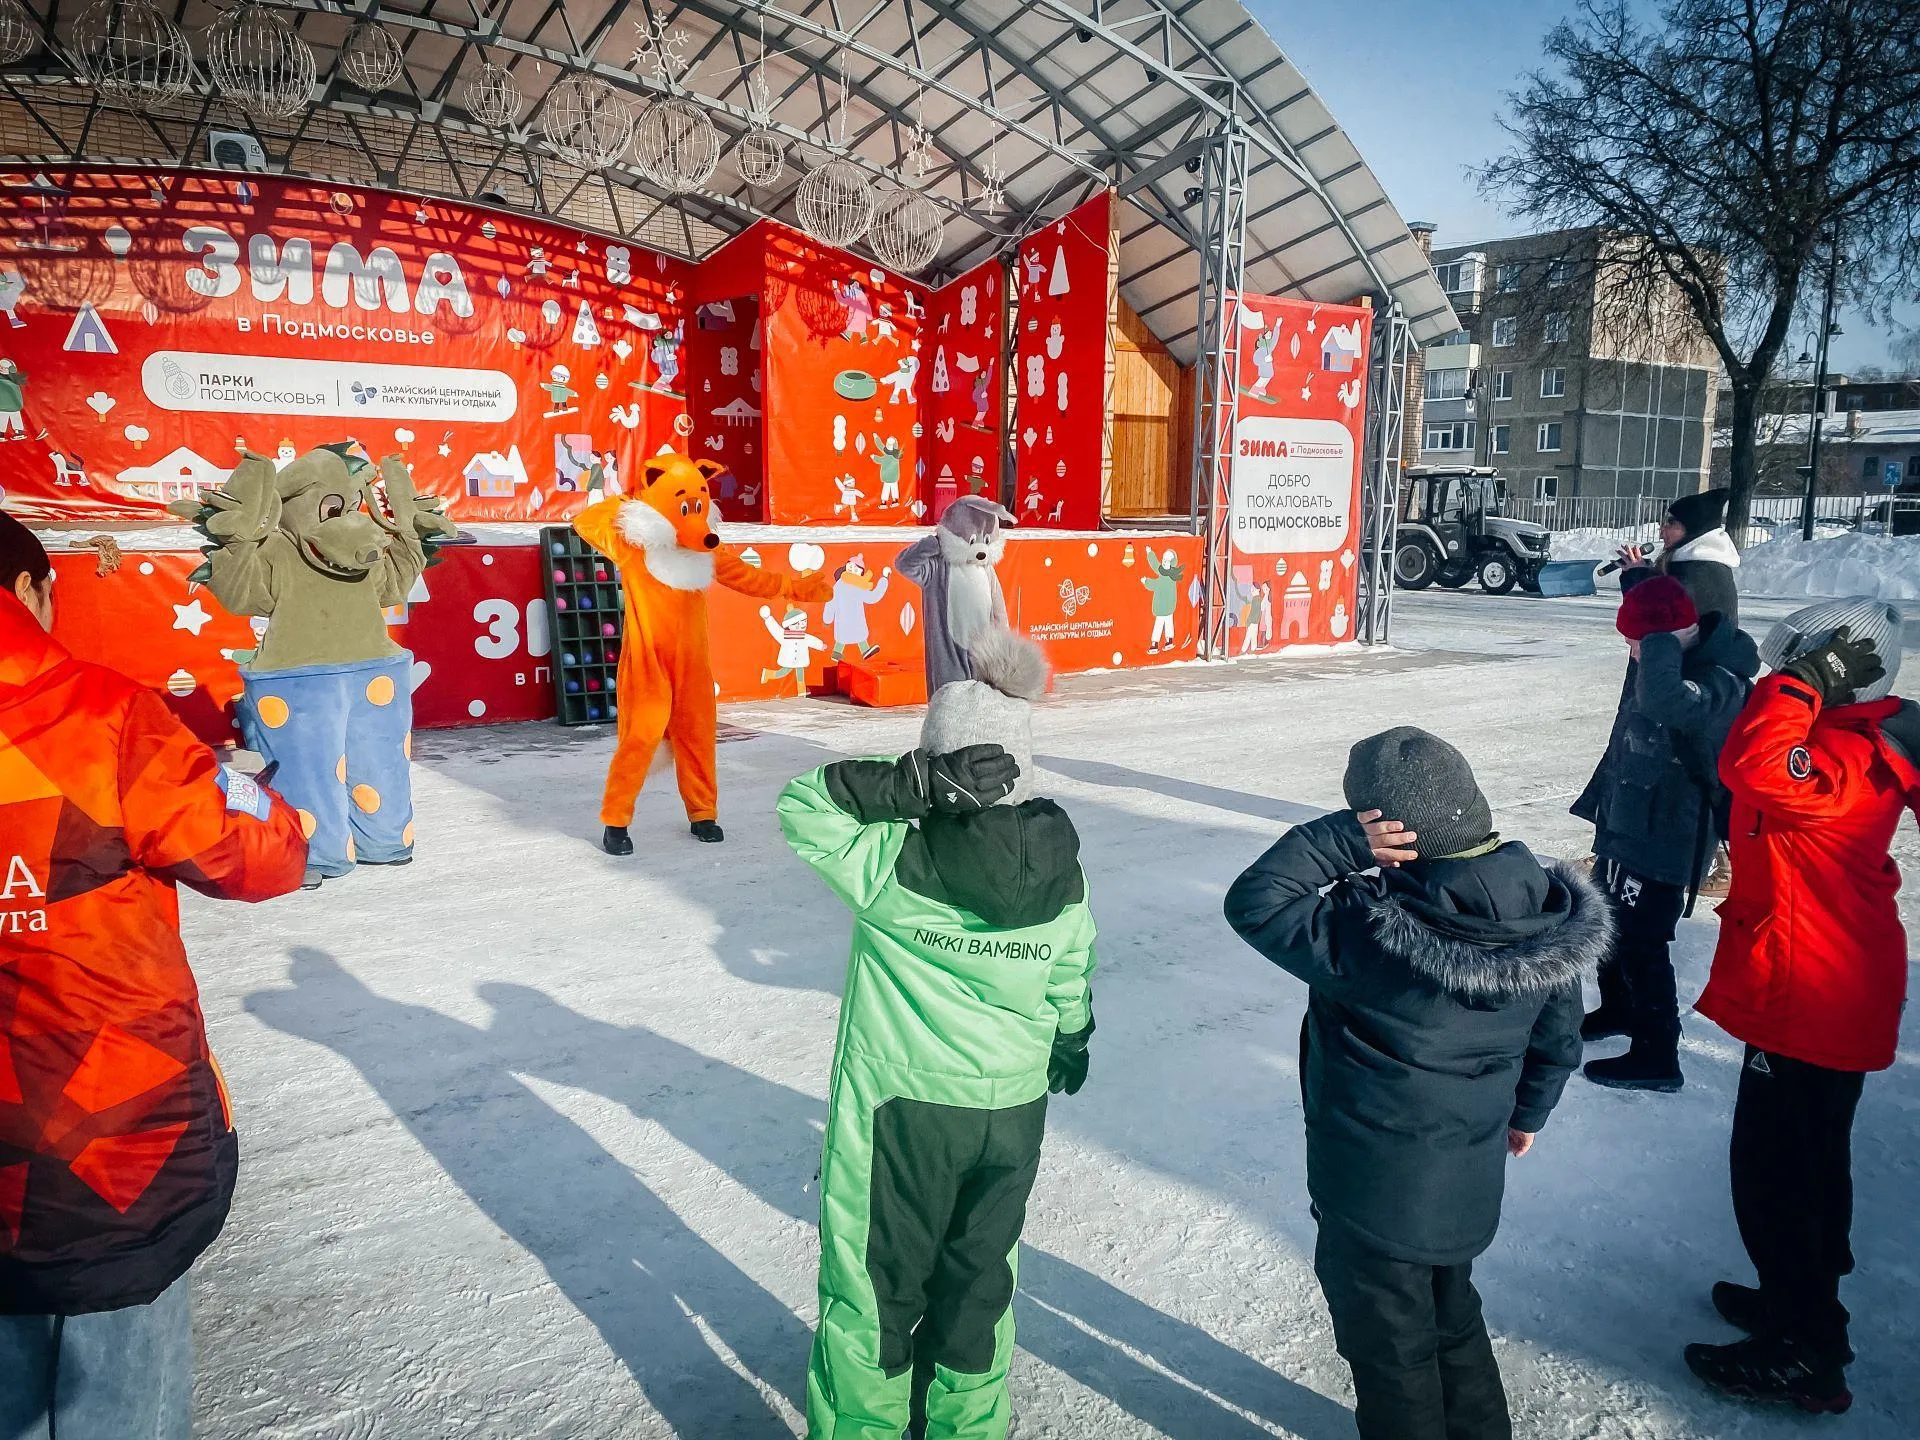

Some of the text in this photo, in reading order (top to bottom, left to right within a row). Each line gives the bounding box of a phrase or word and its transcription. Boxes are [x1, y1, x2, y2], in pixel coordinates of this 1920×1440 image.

[182, 226, 475, 318] ЗИМА
[237, 313, 435, 345] в Подмосковье
[200, 374, 254, 388] ПАРКИ
[200, 388, 325, 405] ПОДМОСКОВЬЯ
[381, 385, 502, 399] ЗАРАЙСКИЙ ЦЕНТРАЛЬНЫЙ
[382, 396, 406, 404] ПАРК
[408, 396, 451, 406] КУЛЬТУРЫ
[461, 399, 497, 409] ОТДЫХА
[1239, 439, 1288, 458] ЗИМА
[1297, 445, 1344, 456] Подмосковье
[1268, 474, 1311, 490] ДОБРО
[1247, 495, 1333, 509] ПОЖАЛОВАТЬ
[1238, 515, 1343, 531] В ПОДМОСКОВЬЕ
[1030, 619, 1114, 632] ЗАРАЙСКИЙ ЦЕНТРАЛЬНЫЙ
[1031, 629, 1112, 641] ПАРК КУЛЬТУРЫ И ОТДЫХА
[515, 672, 526, 686] в
[913, 929, 1052, 961] NIKKI BAMBINO
